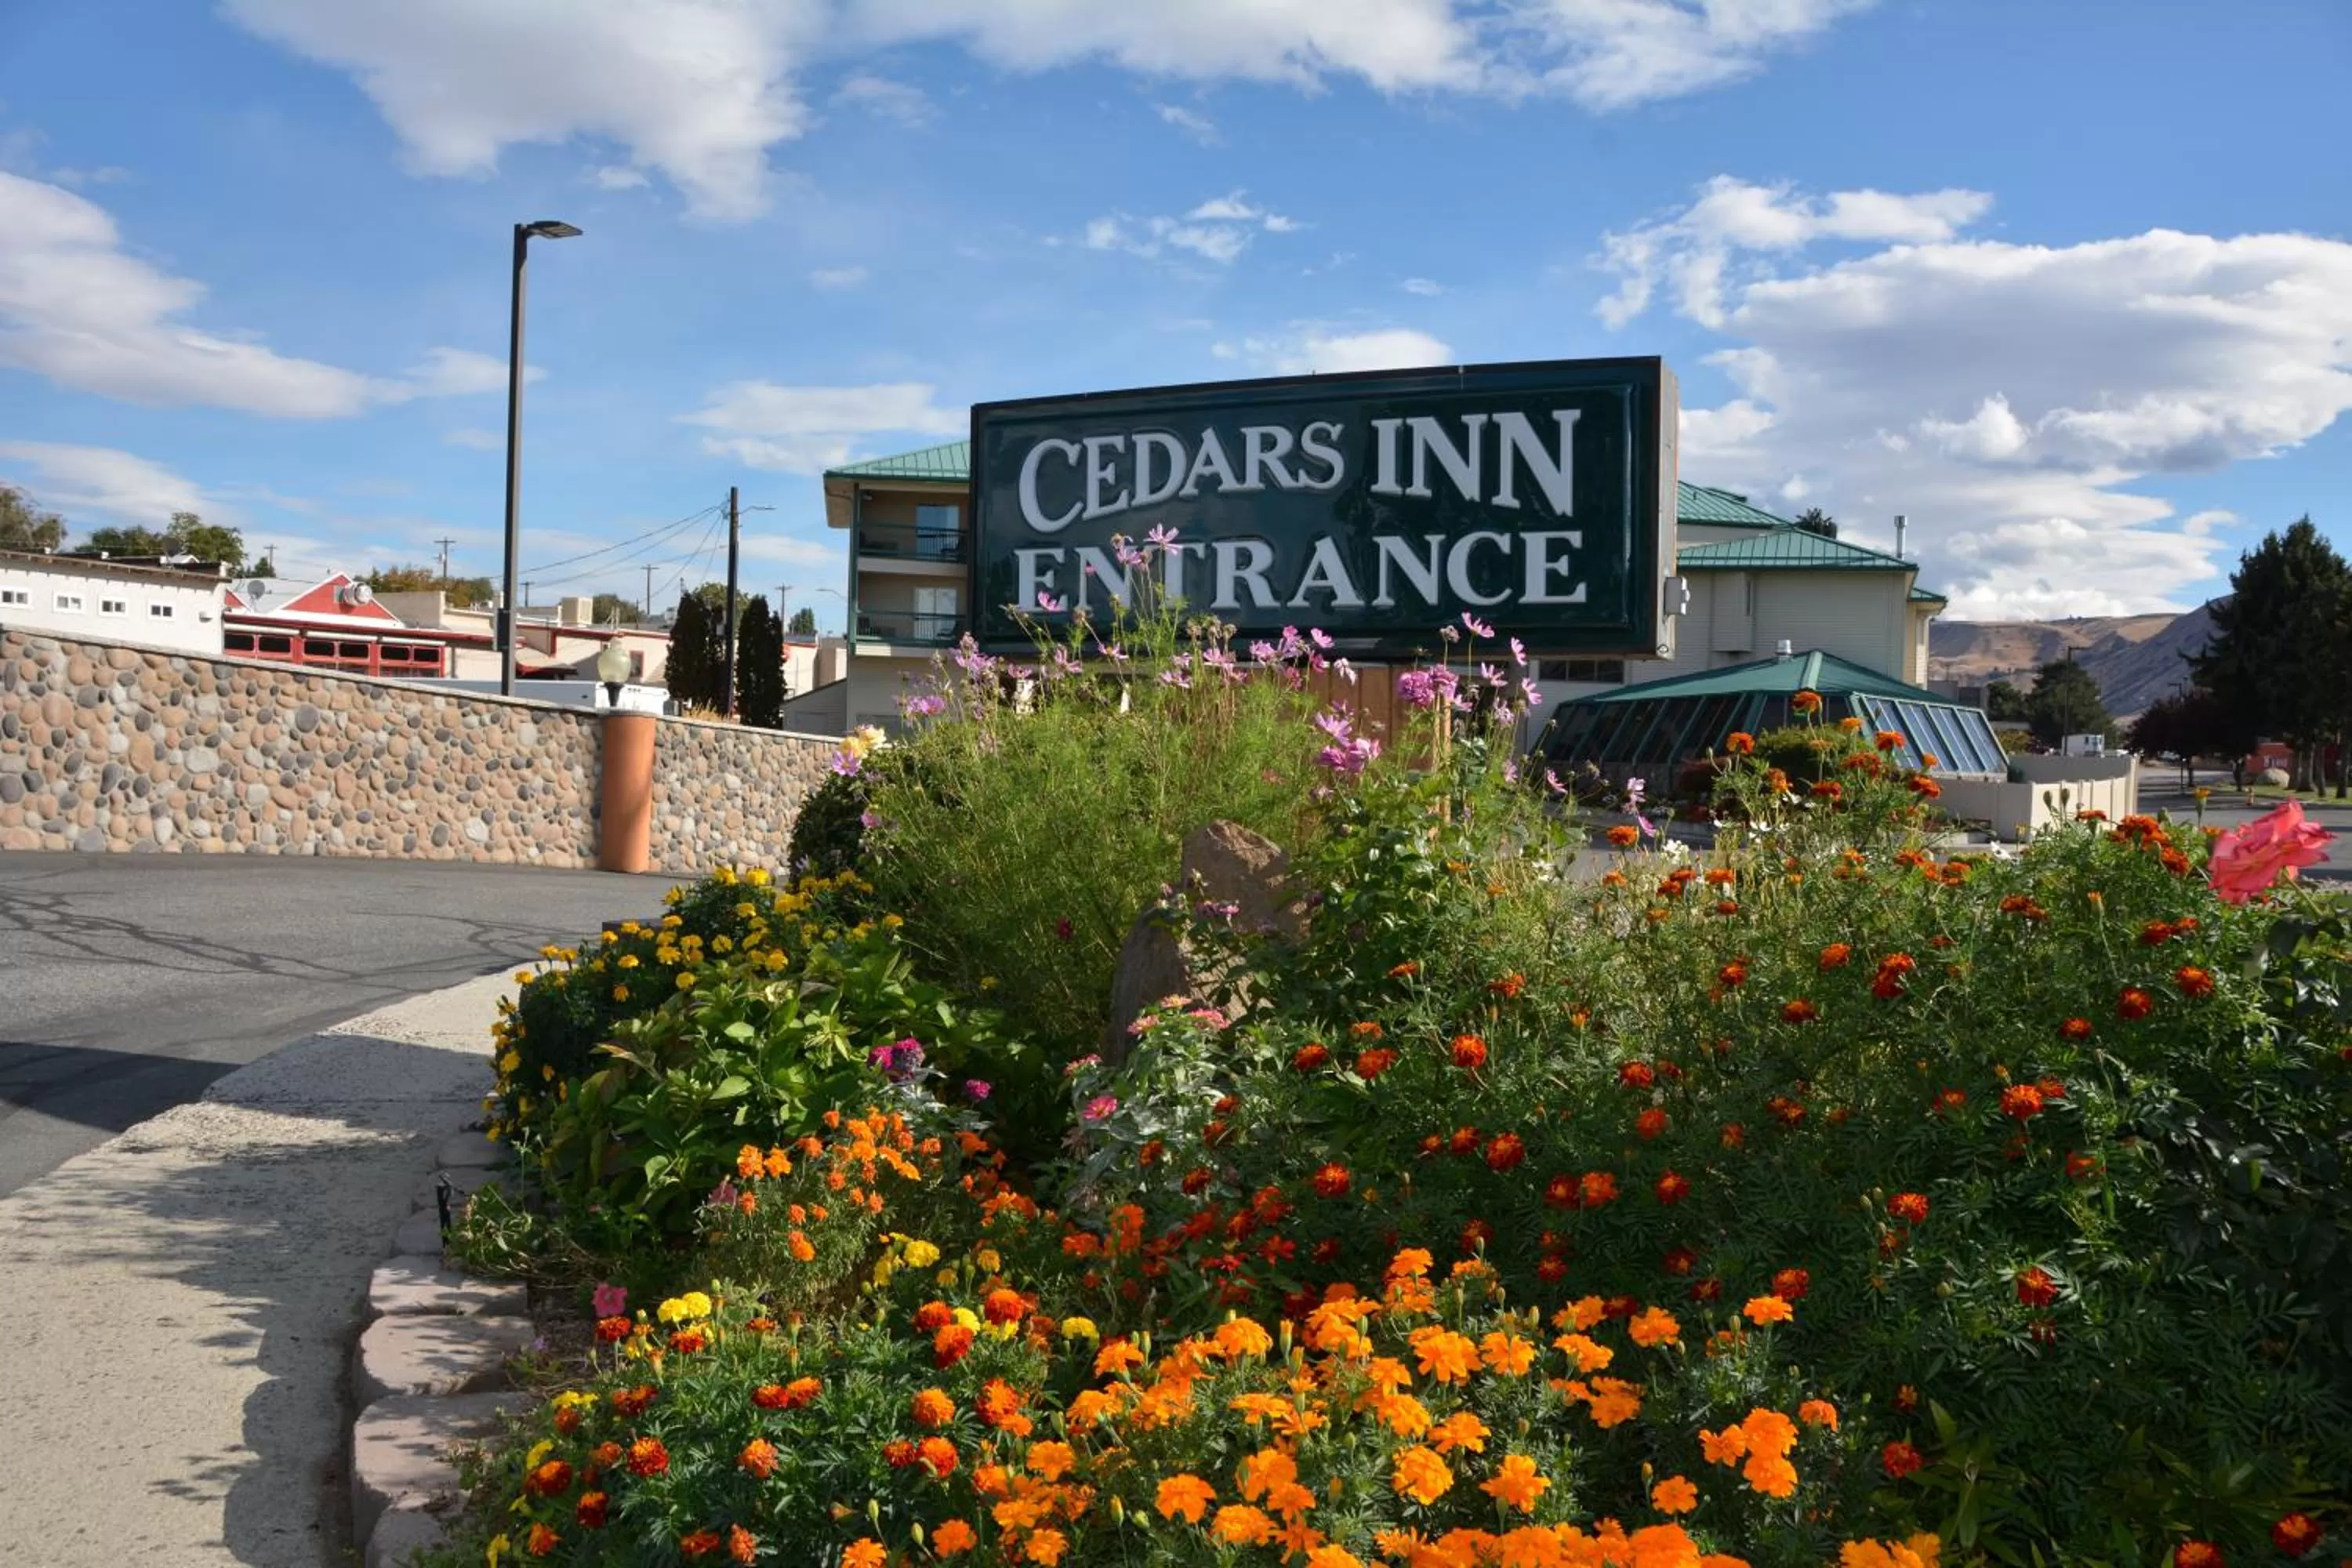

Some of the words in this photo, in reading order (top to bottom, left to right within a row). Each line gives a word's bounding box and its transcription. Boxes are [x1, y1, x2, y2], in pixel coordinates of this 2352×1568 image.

[1018, 422, 1345, 533] CEDARS
[1371, 408, 1581, 516] INN
[1014, 531, 1588, 612] ENTRANCE
